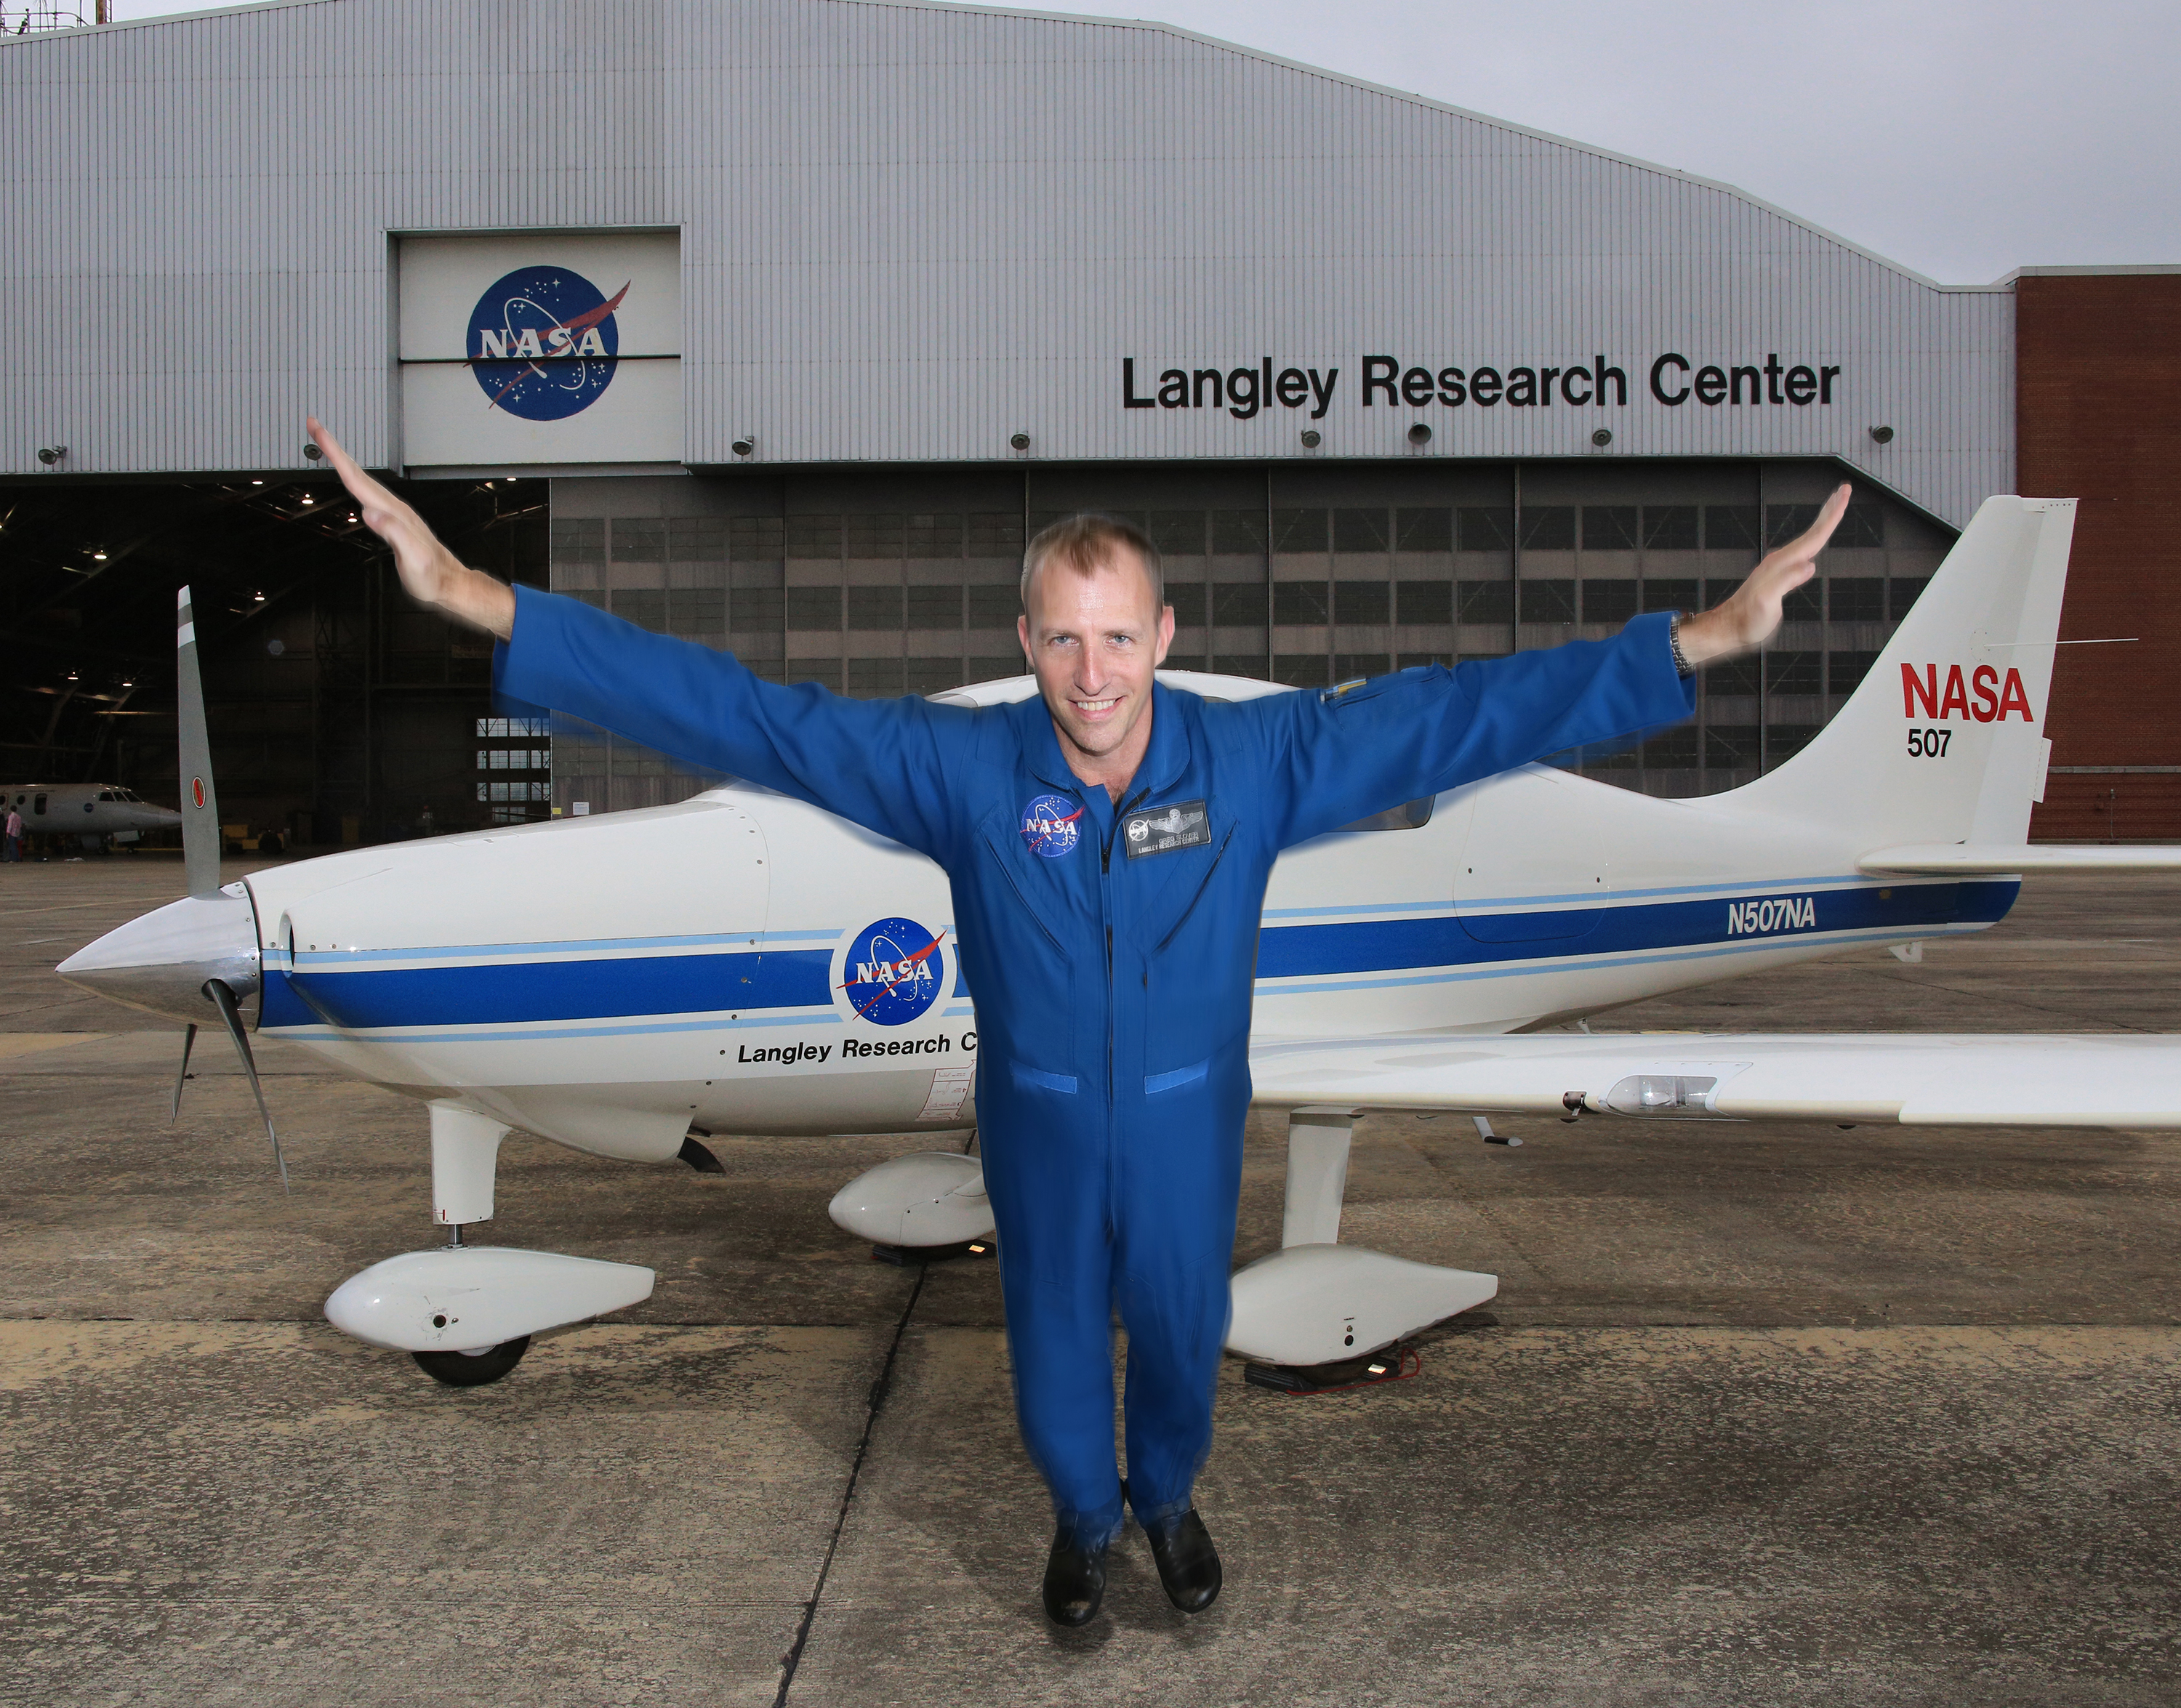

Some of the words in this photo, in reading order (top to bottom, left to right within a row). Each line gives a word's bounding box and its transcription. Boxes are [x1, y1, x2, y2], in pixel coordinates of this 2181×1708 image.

[480, 328, 608, 358] NASA
[1123, 357, 1338, 419] Langley
[1361, 355, 1626, 407] Research
[1650, 353, 1840, 405] Center
[1900, 663, 2034, 722] NASA
[1907, 728, 1952, 757] 507
[1026, 818, 1077, 835] NASA
[1138, 844, 1158, 853] LANGLEY
[1159, 840, 1181, 849] RESEARCH
[1727, 897, 1816, 934] N507NA
[856, 959, 933, 984] NASA
[738, 1042, 832, 1065] Langley
[842, 1034, 951, 1058] Research
